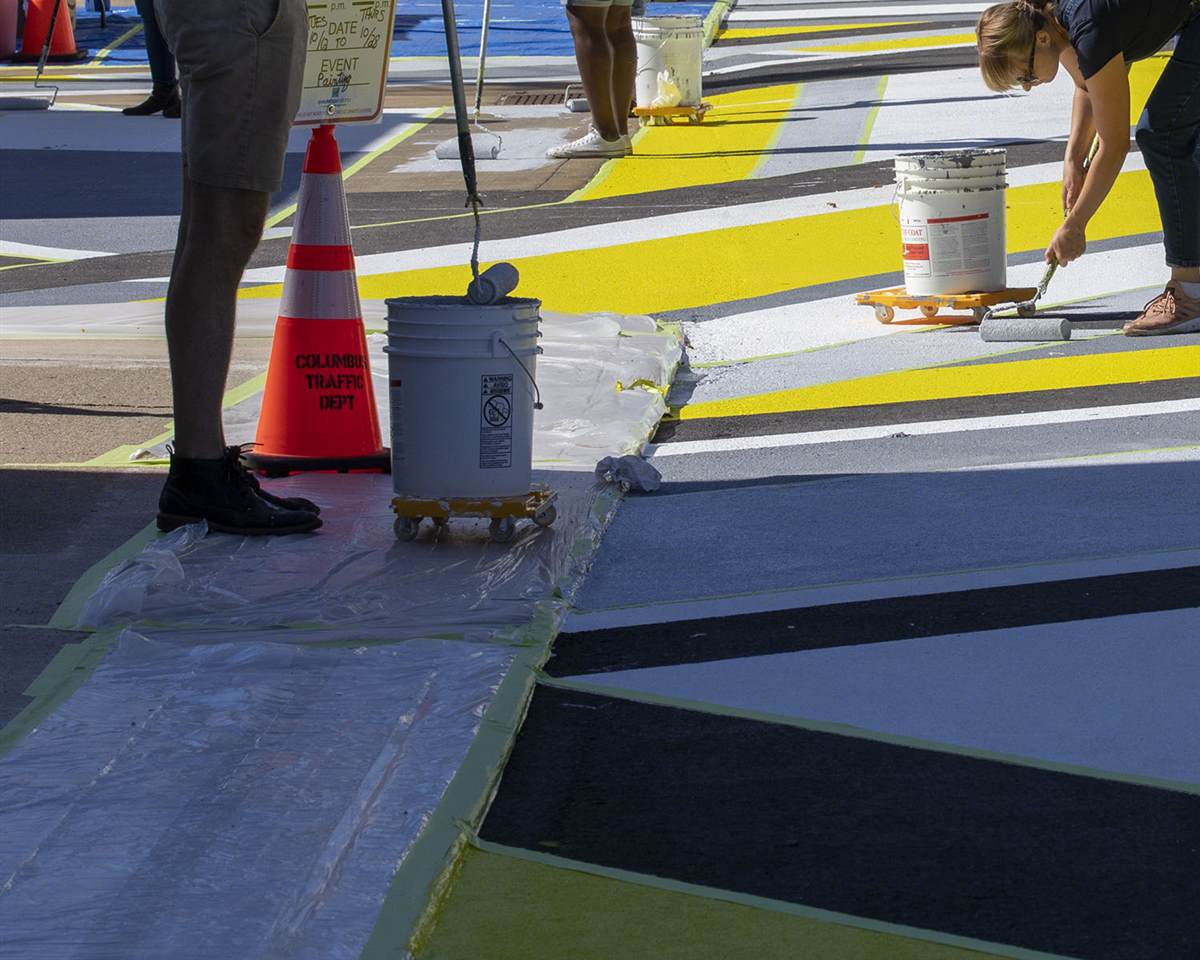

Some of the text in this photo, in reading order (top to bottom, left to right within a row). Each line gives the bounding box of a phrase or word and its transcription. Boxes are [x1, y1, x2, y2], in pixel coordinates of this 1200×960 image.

[328, 21, 358, 36] DATE
[335, 36, 347, 49] TO
[320, 57, 359, 72] EVENT
[304, 374, 364, 390] TRAFFIC
[319, 395, 355, 410] DEPT
